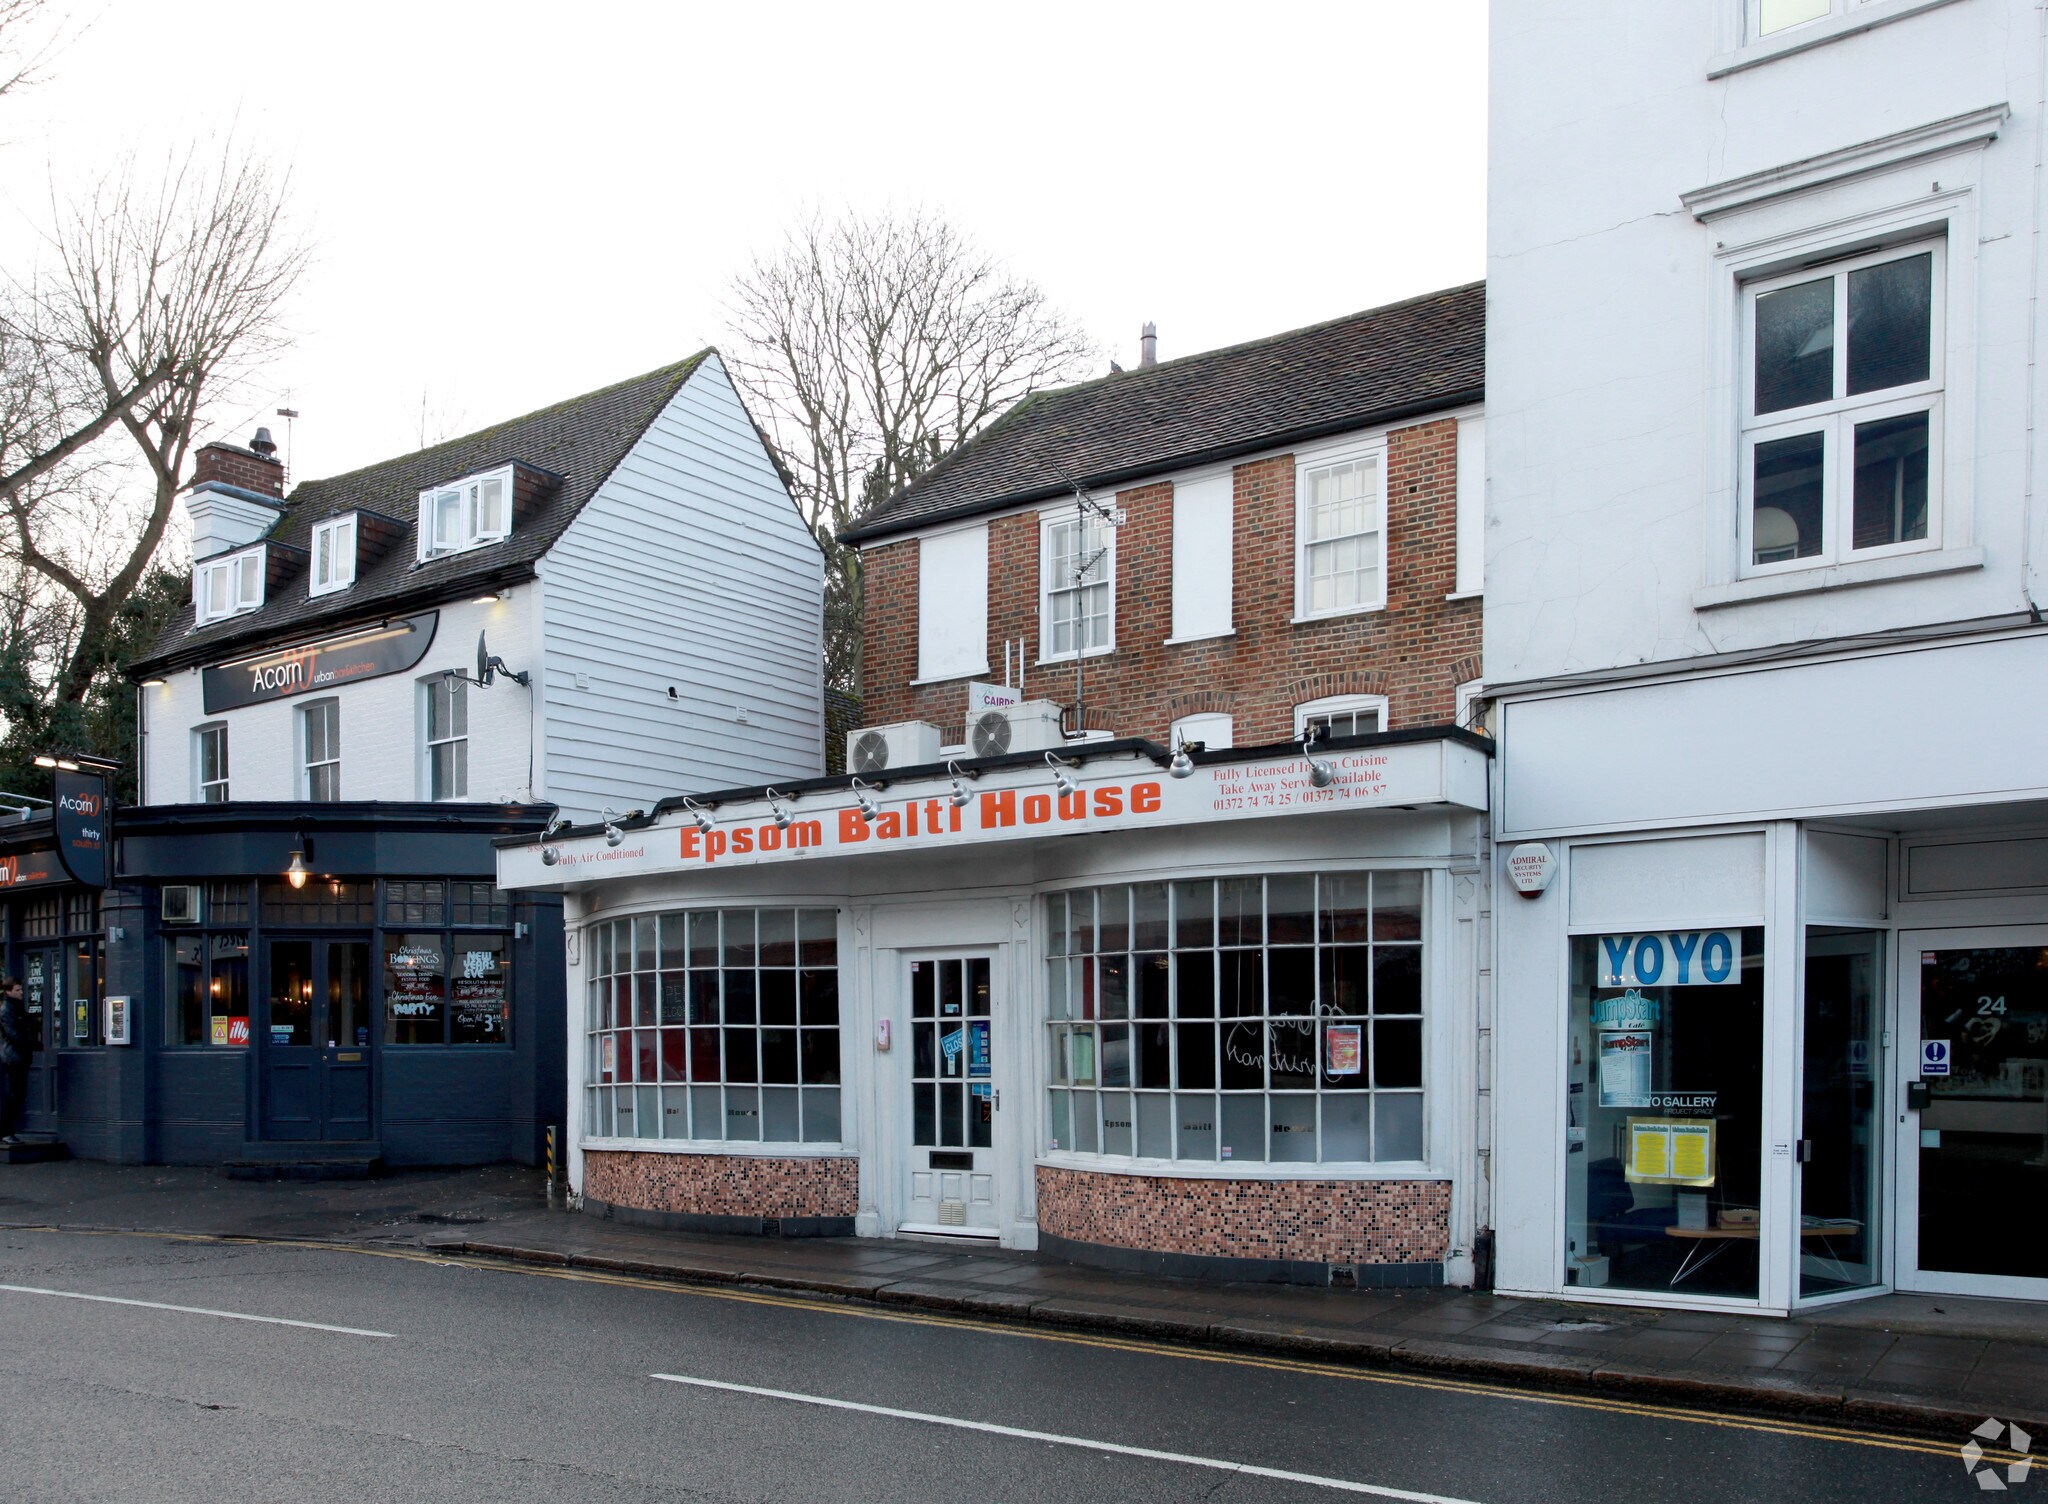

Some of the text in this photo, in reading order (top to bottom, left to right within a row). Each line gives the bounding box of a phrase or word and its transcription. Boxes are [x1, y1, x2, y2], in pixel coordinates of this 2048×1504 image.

[253, 663, 302, 692] Acorn
[1213, 768, 1241, 782] Fully
[1245, 762, 1295, 778] Licensed
[1341, 754, 1388, 769] Cuisine
[1219, 782, 1244, 795] Take
[1248, 779, 1276, 794] Away
[60, 795, 93, 812] Acorn
[1213, 797, 1243, 811] 01372
[1248, 796, 1258, 808] 74
[1263, 794, 1274, 806] 74
[1279, 793, 1291, 805] 25
[1302, 788, 1334, 803] 01372
[1338, 787, 1350, 800] 74
[1355, 786, 1368, 798] 06
[1373, 784, 1387, 797] 87
[681, 781, 1161, 863] Epsom Balti House
[82, 828, 100, 840] thirty
[558, 847, 644, 867] Fully Air Conditioned
[1511, 856, 1547, 865] ADMIRAL
[467, 951, 492, 961] NEW
[1601, 932, 1733, 986] YOYO
[463, 960, 495, 970] YEARS
[464, 969, 485, 979] EVE
[393, 1002, 435, 1016] PARTY
[1977, 995, 2007, 1015] 24
[484, 1014, 494, 1032] 3
[229, 1021, 249, 1043] illy
[1663, 1096, 1717, 1107] GALLERY
[1104, 1119, 1132, 1128] Epsom
